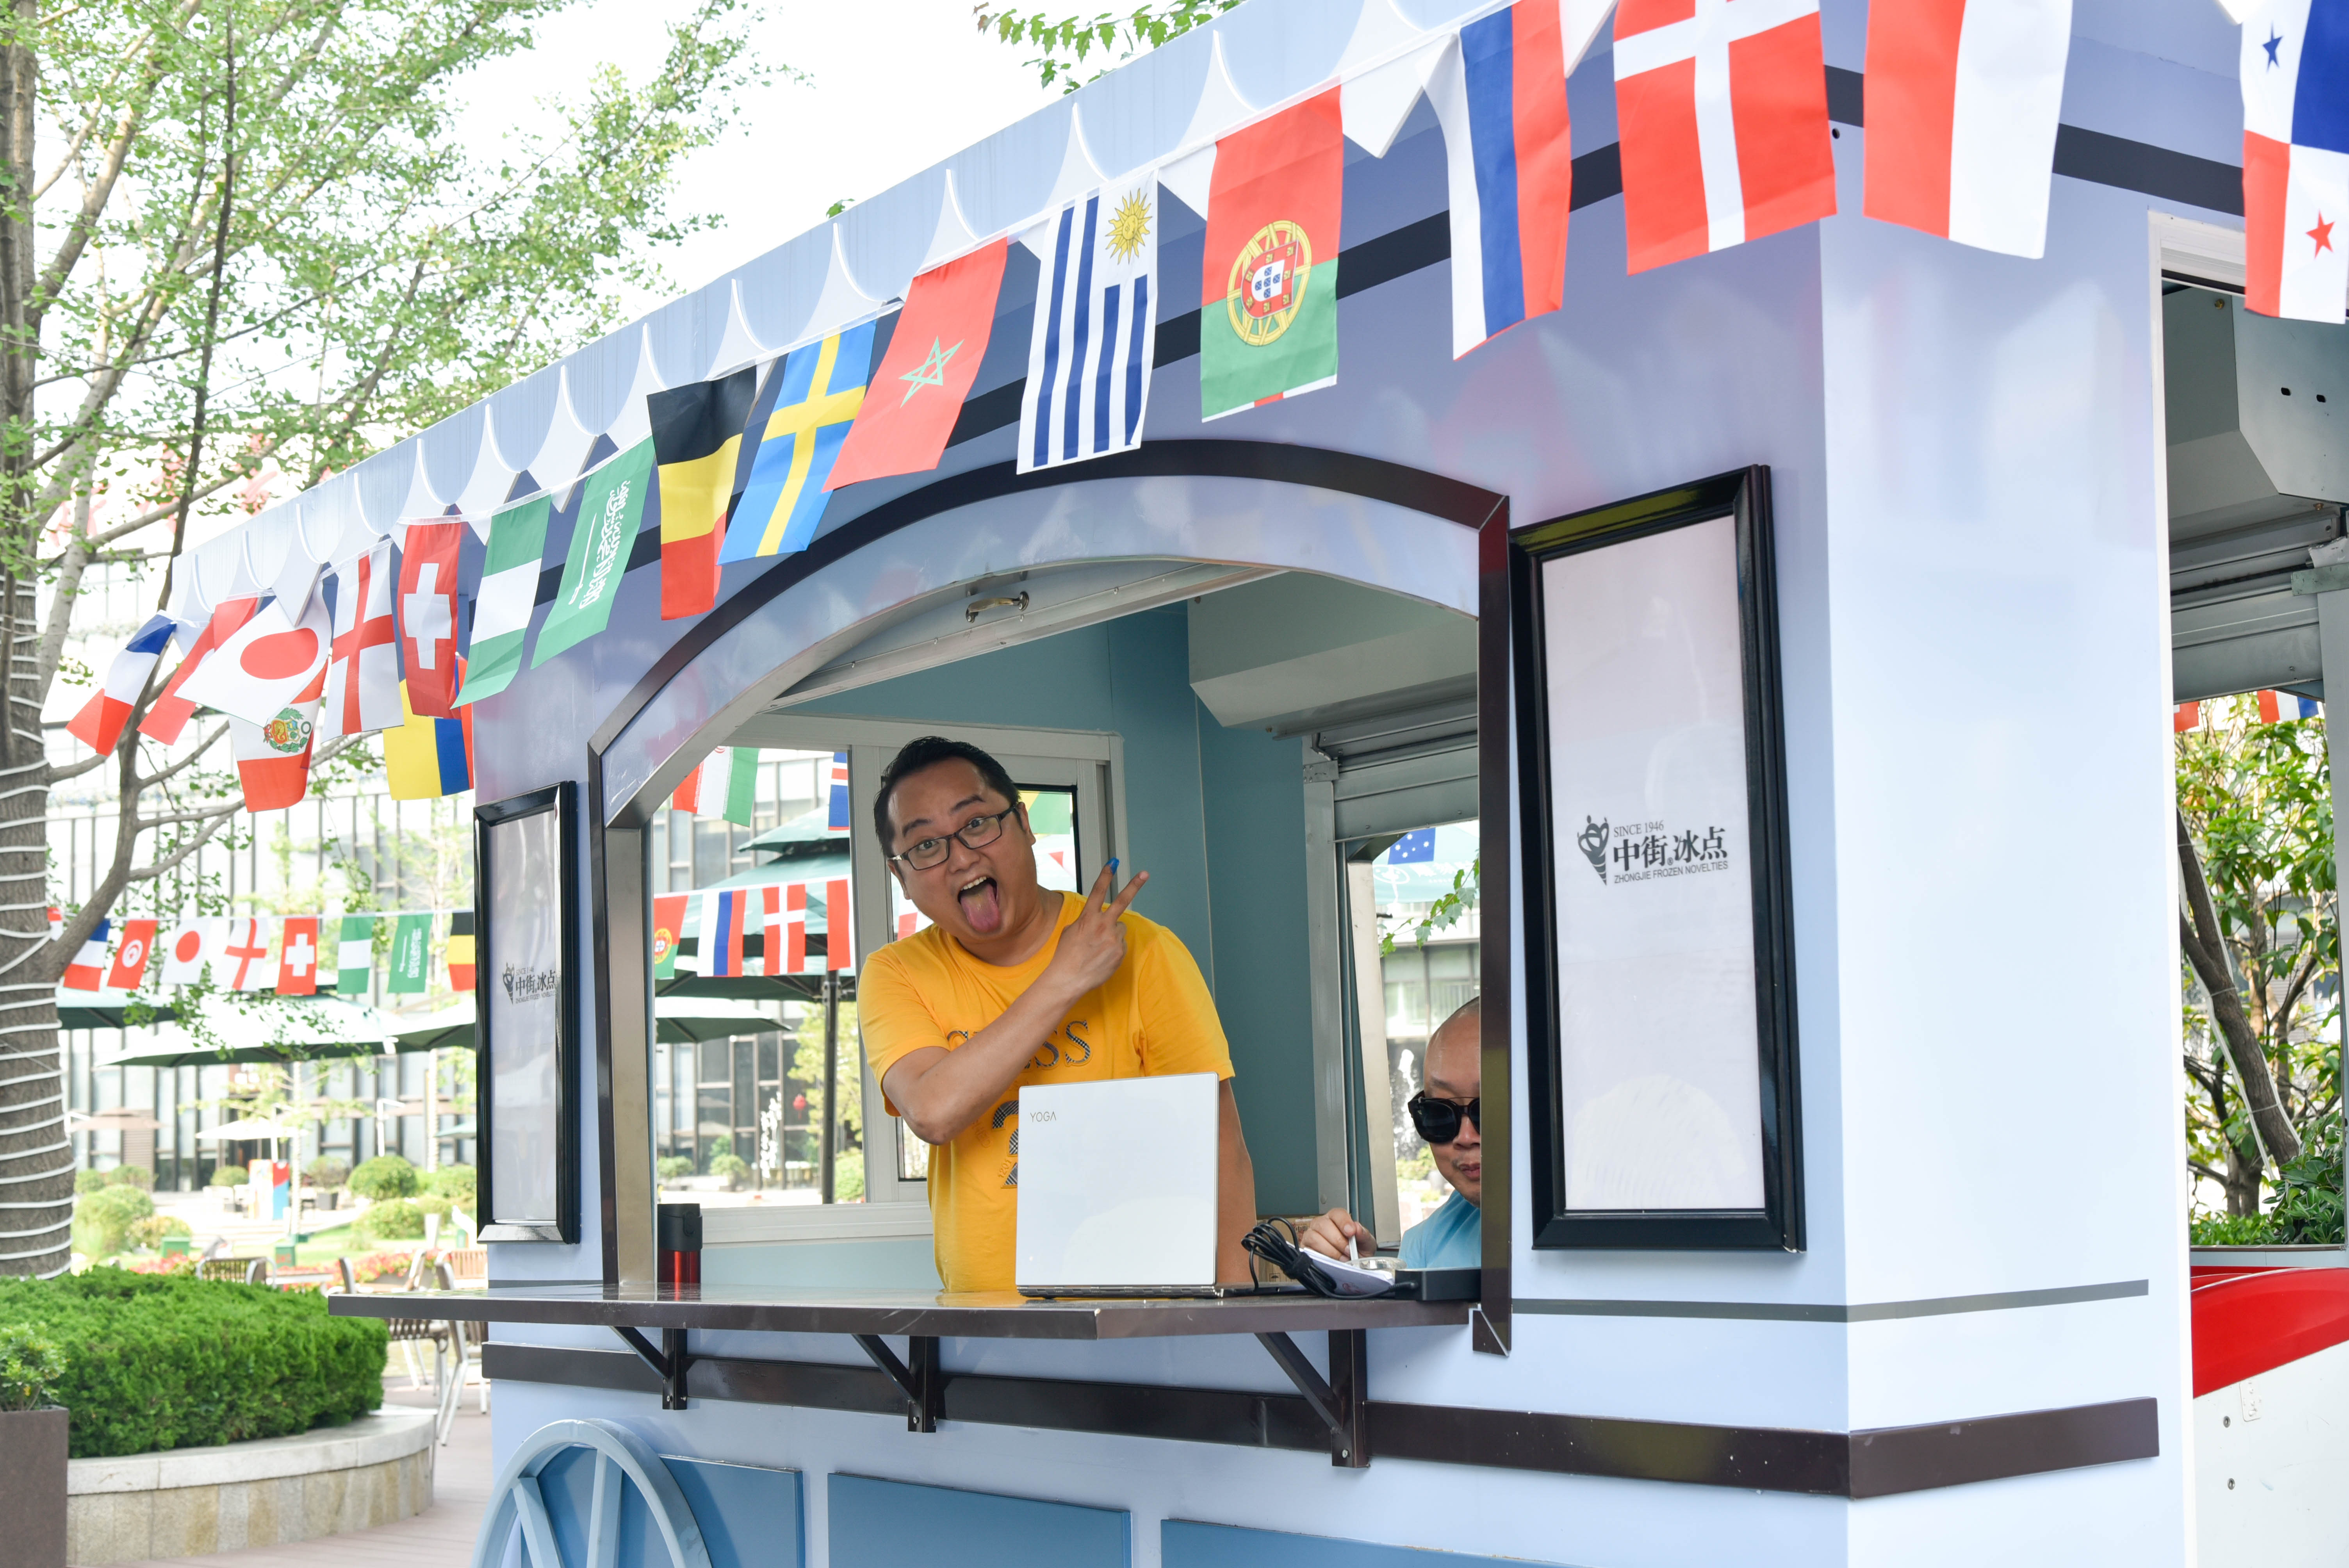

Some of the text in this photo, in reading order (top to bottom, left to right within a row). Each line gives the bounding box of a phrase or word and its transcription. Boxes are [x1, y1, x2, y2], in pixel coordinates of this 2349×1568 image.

[1614, 820, 1664, 837] SINCE 1946
[1614, 861, 1729, 884] ZHONGJIE FROZEN NOVELTIES
[1030, 1111, 1057, 1123] YOGA
